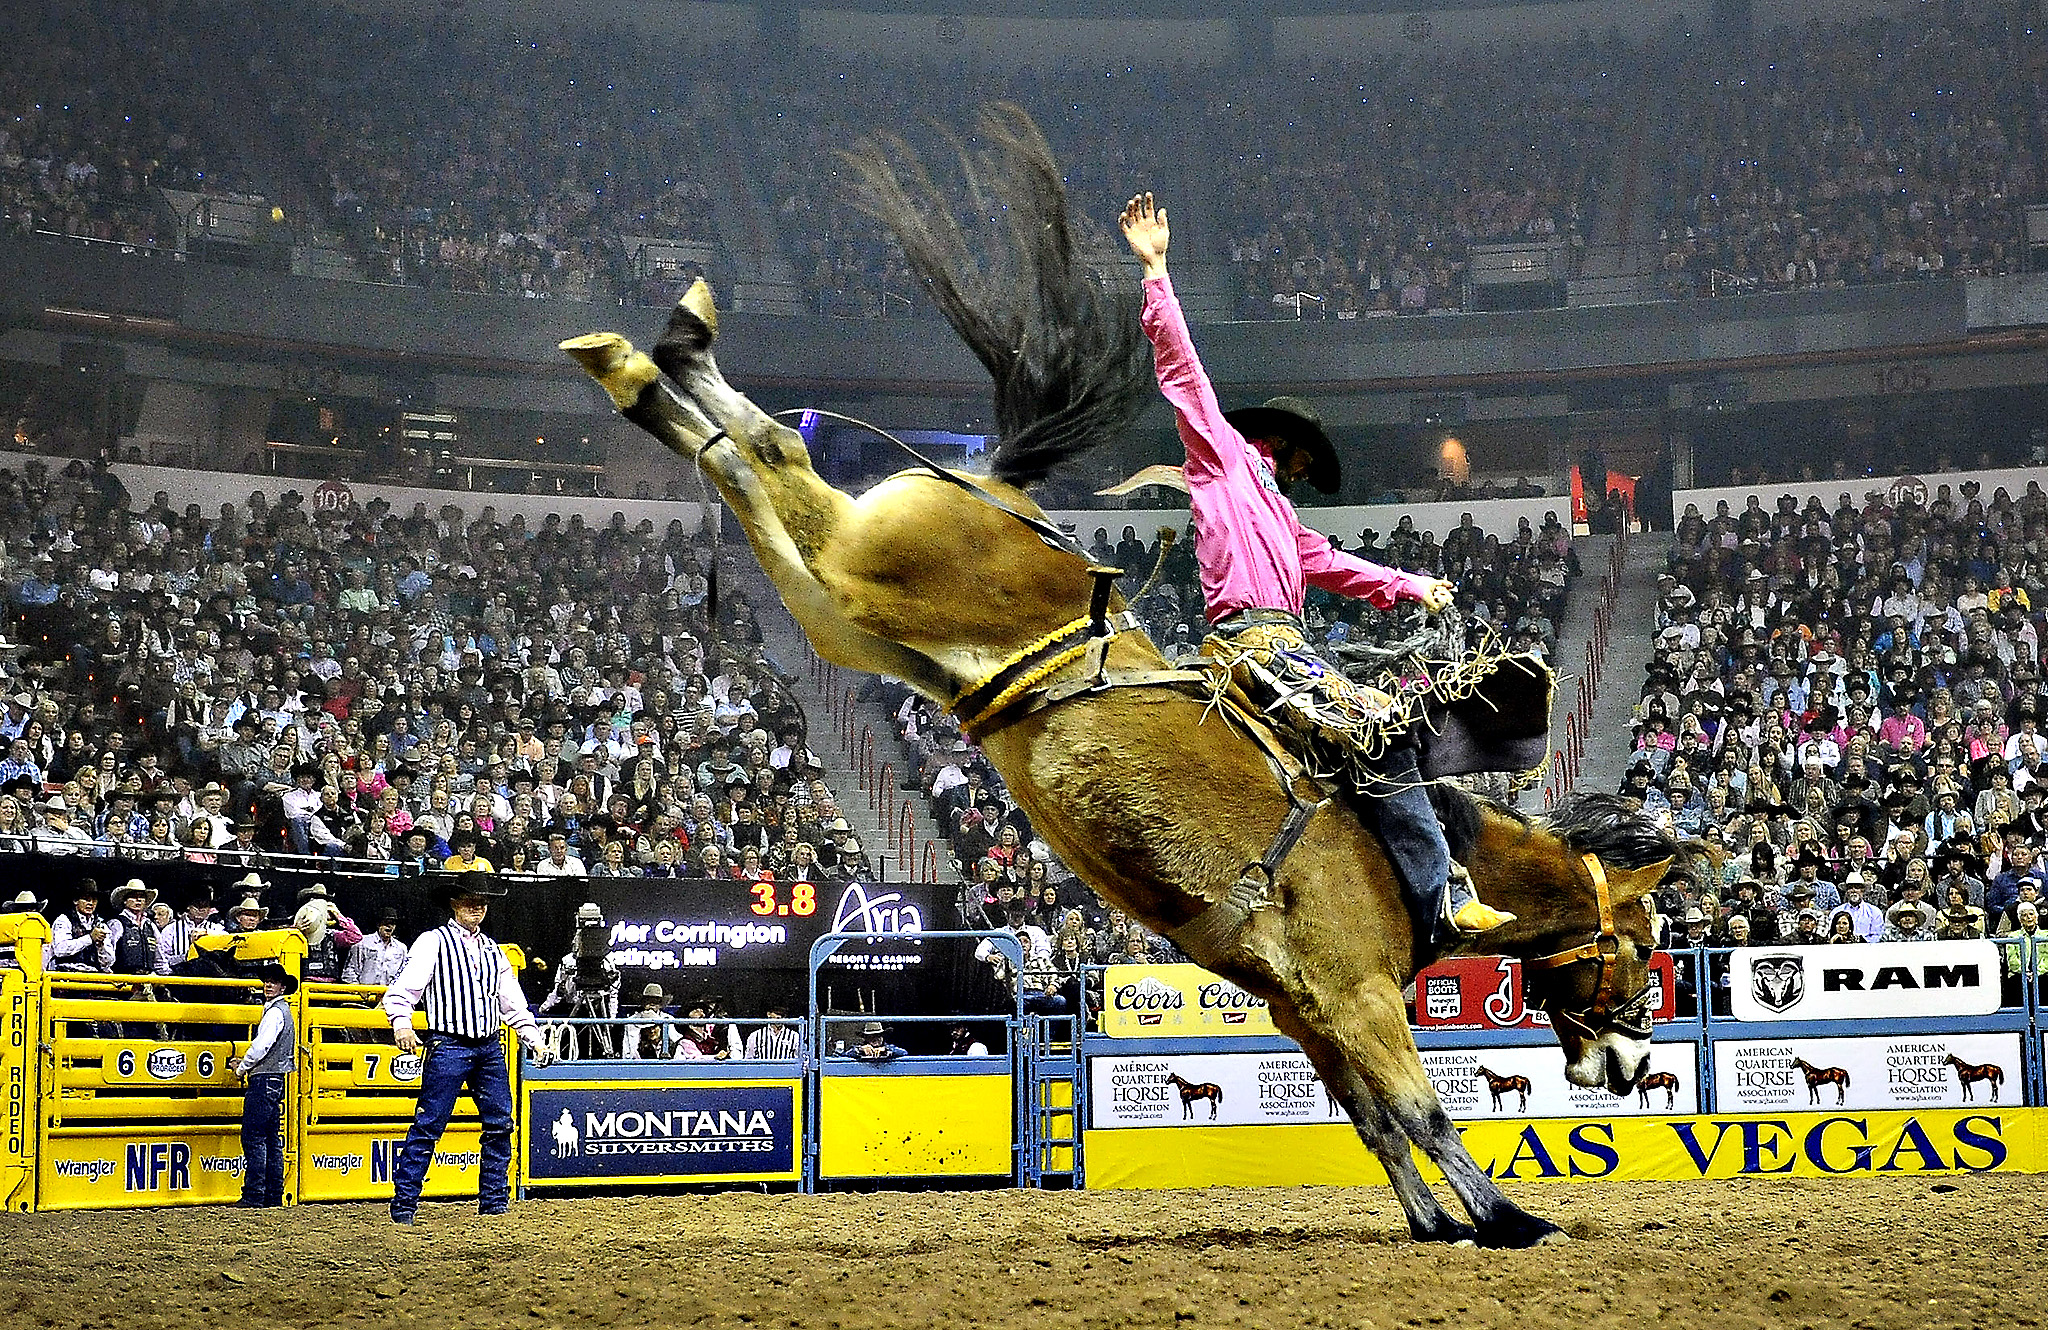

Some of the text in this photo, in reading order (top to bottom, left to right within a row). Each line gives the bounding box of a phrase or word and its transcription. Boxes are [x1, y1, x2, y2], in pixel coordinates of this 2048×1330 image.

[316, 489, 349, 511] 103
[750, 882, 817, 916] 3.8
[831, 882, 922, 945] Aria
[654, 920, 786, 949] Corrington
[611, 948, 717, 970] stings, MN
[1823, 964, 1979, 991] RAM
[1114, 984, 1184, 1010] Coors
[1428, 986, 1458, 995] BOOTS
[1429, 1005, 1458, 1015] NFR
[1736, 1047, 1793, 1056] AMERICAN
[1887, 1044, 1945, 1053] AMERICAN
[117, 1050, 135, 1077] 6
[197, 1051, 214, 1078] 6
[364, 1055, 380, 1080] 7
[1113, 1063, 1168, 1072] AMERICAN
[1422, 1056, 1477, 1064] AMERICAN
[1735, 1059, 1792, 1071] QUARTER
[1887, 1055, 1944, 1067] QUARTER
[8, 995, 23, 1154] PRO RODEO
[1112, 1075, 1167, 1086] QUARTER
[1258, 1072, 1314, 1083] QUARTER
[1737, 1089, 1795, 1097] ASSOCIATION
[1113, 1104, 1169, 1112] ASSOCIATION
[585, 1110, 773, 1137] MONTANA
[585, 1141, 774, 1155] SILVERSMITHS
[1456, 1116, 2008, 1178] AS VEGAS
[55, 1142, 248, 1192] Wrangler NFR Wrangle
[311, 1139, 480, 1183] Wrangler NF Wrangler
